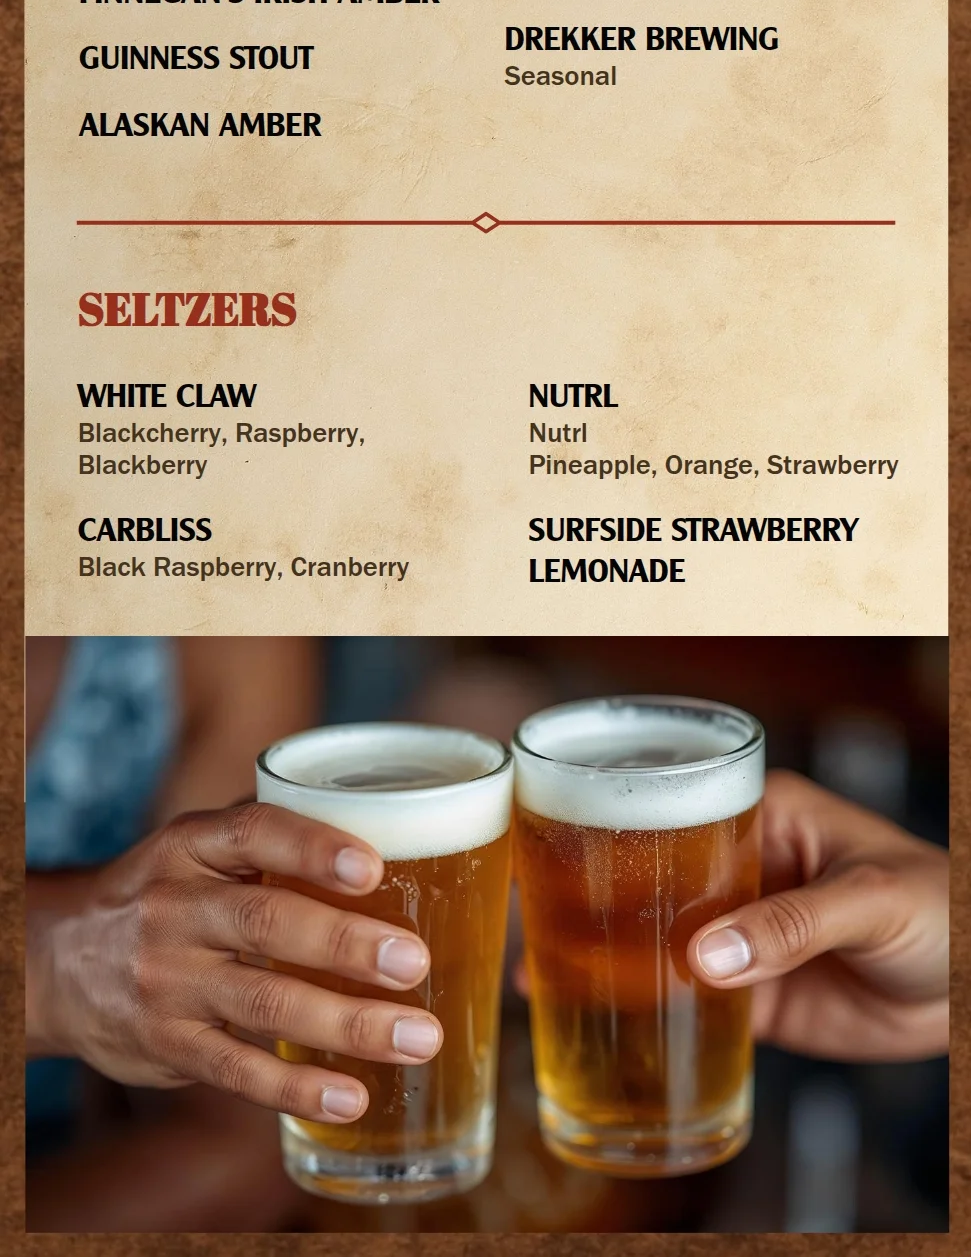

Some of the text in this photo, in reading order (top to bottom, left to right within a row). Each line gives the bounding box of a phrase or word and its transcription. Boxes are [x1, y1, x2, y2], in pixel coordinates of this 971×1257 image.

[506, 27, 778, 50] DREKKER BREWING
[80, 46, 314, 69] GUINNESS STOUT
[79, 113, 322, 136] ALASKAN AMBER
[79, 292, 296, 326] SELTZERS
[77, 384, 257, 407] WHITE CLAW
[530, 384, 619, 407] NUTRL
[80, 423, 364, 447] Blackcherry, Raspberry,
[530, 423, 586, 442] Nutrl
[80, 455, 207, 479] Blackberry
[530, 455, 899, 479] Pineapple, Orange, Strawberry
[78, 518, 212, 541] CARBLISS
[529, 518, 860, 541] SURFSIDE STRAWBERRY
[80, 557, 409, 581] Black Raspberry, Cranberry
[530, 559, 685, 582] LEMONADE
